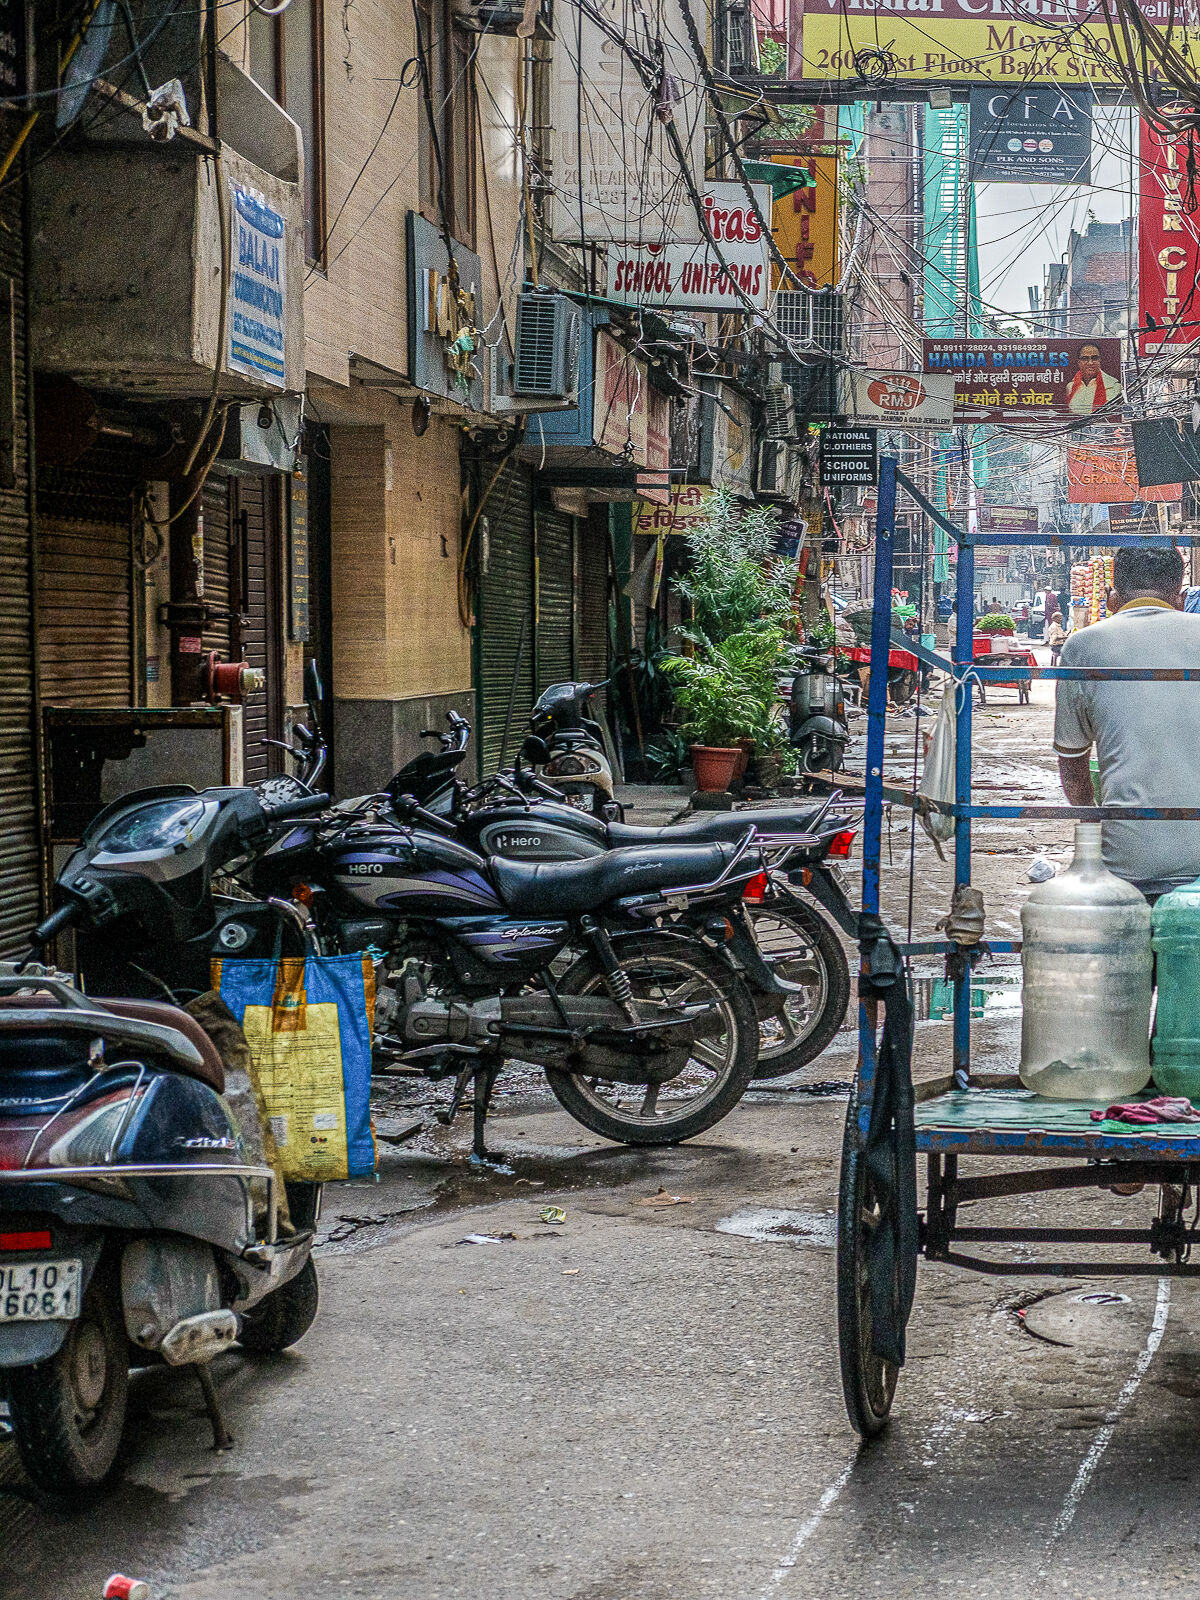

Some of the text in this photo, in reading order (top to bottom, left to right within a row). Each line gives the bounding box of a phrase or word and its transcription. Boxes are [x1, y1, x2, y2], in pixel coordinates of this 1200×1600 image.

[986, 25, 1111, 54] Move to
[922, 53, 992, 76] Floor,
[999, 58, 1059, 77] Bank
[239, 225, 280, 285] BALAJI
[614, 260, 763, 296] SCHOOL UNIFORMS
[1157, 245, 1188, 339] CITY
[928, 352, 1070, 367] HANDA BANGLES
[879, 394, 913, 408] RMJ
[1003, 388, 1019, 406] के
[825, 432, 870, 440] NATIONAL
[826, 461, 870, 470] SCHOOL
[823, 473, 873, 481] UNIFORMS
[510, 836, 542, 847] Hero
[349, 863, 384, 875] Hero
[30, 1265, 58, 1290] 10
